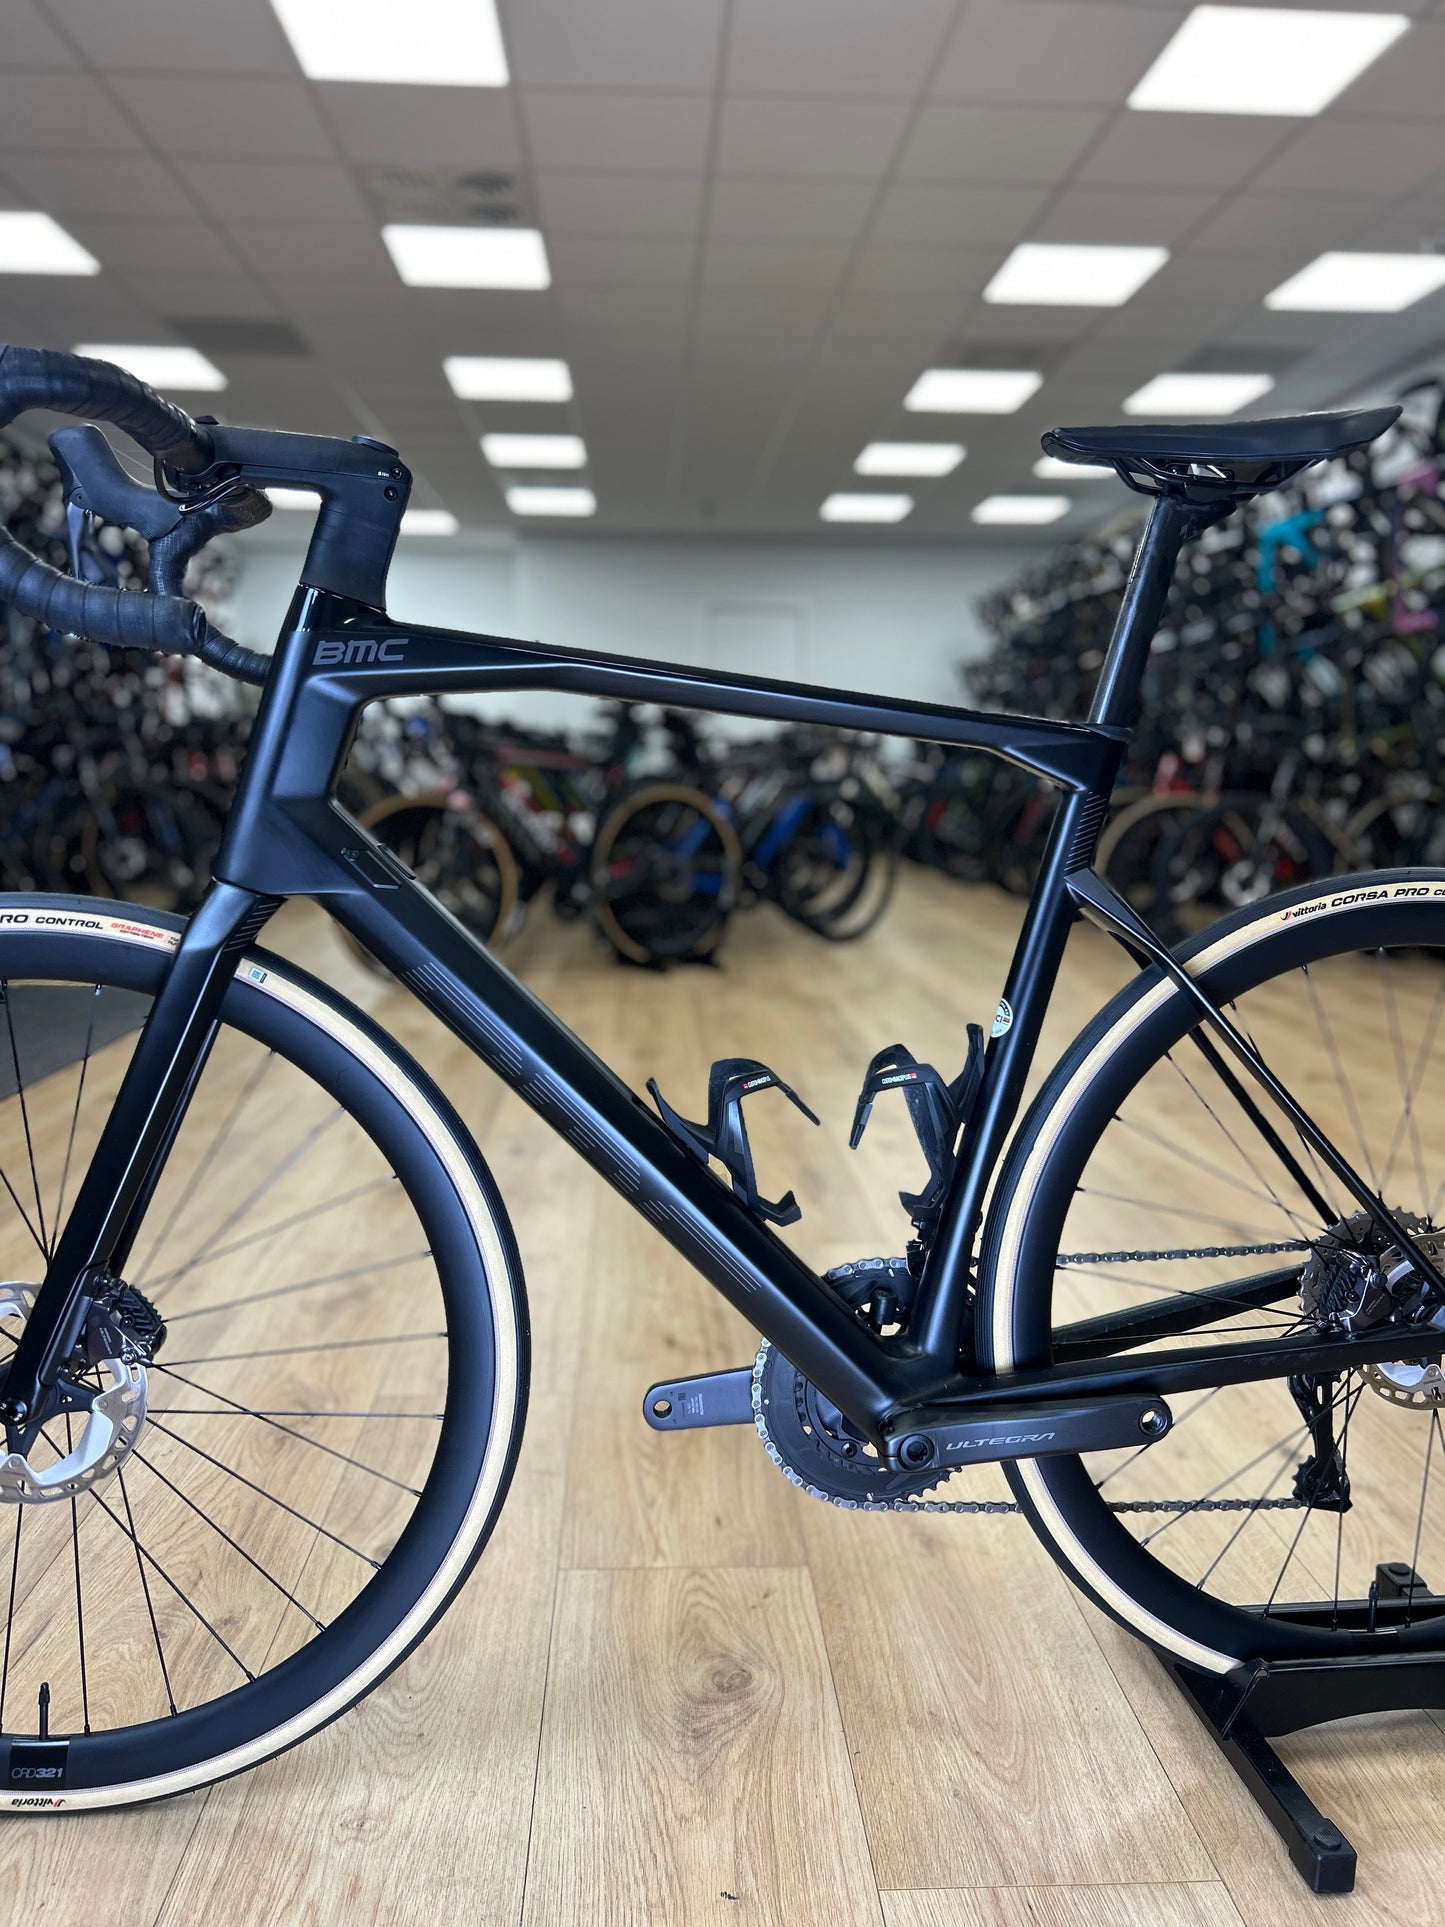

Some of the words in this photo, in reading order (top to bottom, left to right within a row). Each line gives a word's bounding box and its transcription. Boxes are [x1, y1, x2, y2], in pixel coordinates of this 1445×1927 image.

[312, 638, 409, 665] BMC
[1292, 902, 1327, 917] vittoria
[1331, 890, 1389, 907] CORSA
[1393, 887, 1430, 897] PRO
[0, 914, 29, 923] RO
[35, 916, 104, 929] CONTROL
[111, 922, 164, 939] GRAPHENE
[946, 1432, 1056, 1451] ULTEGRA
[11, 1798, 54, 1808] vittoria
